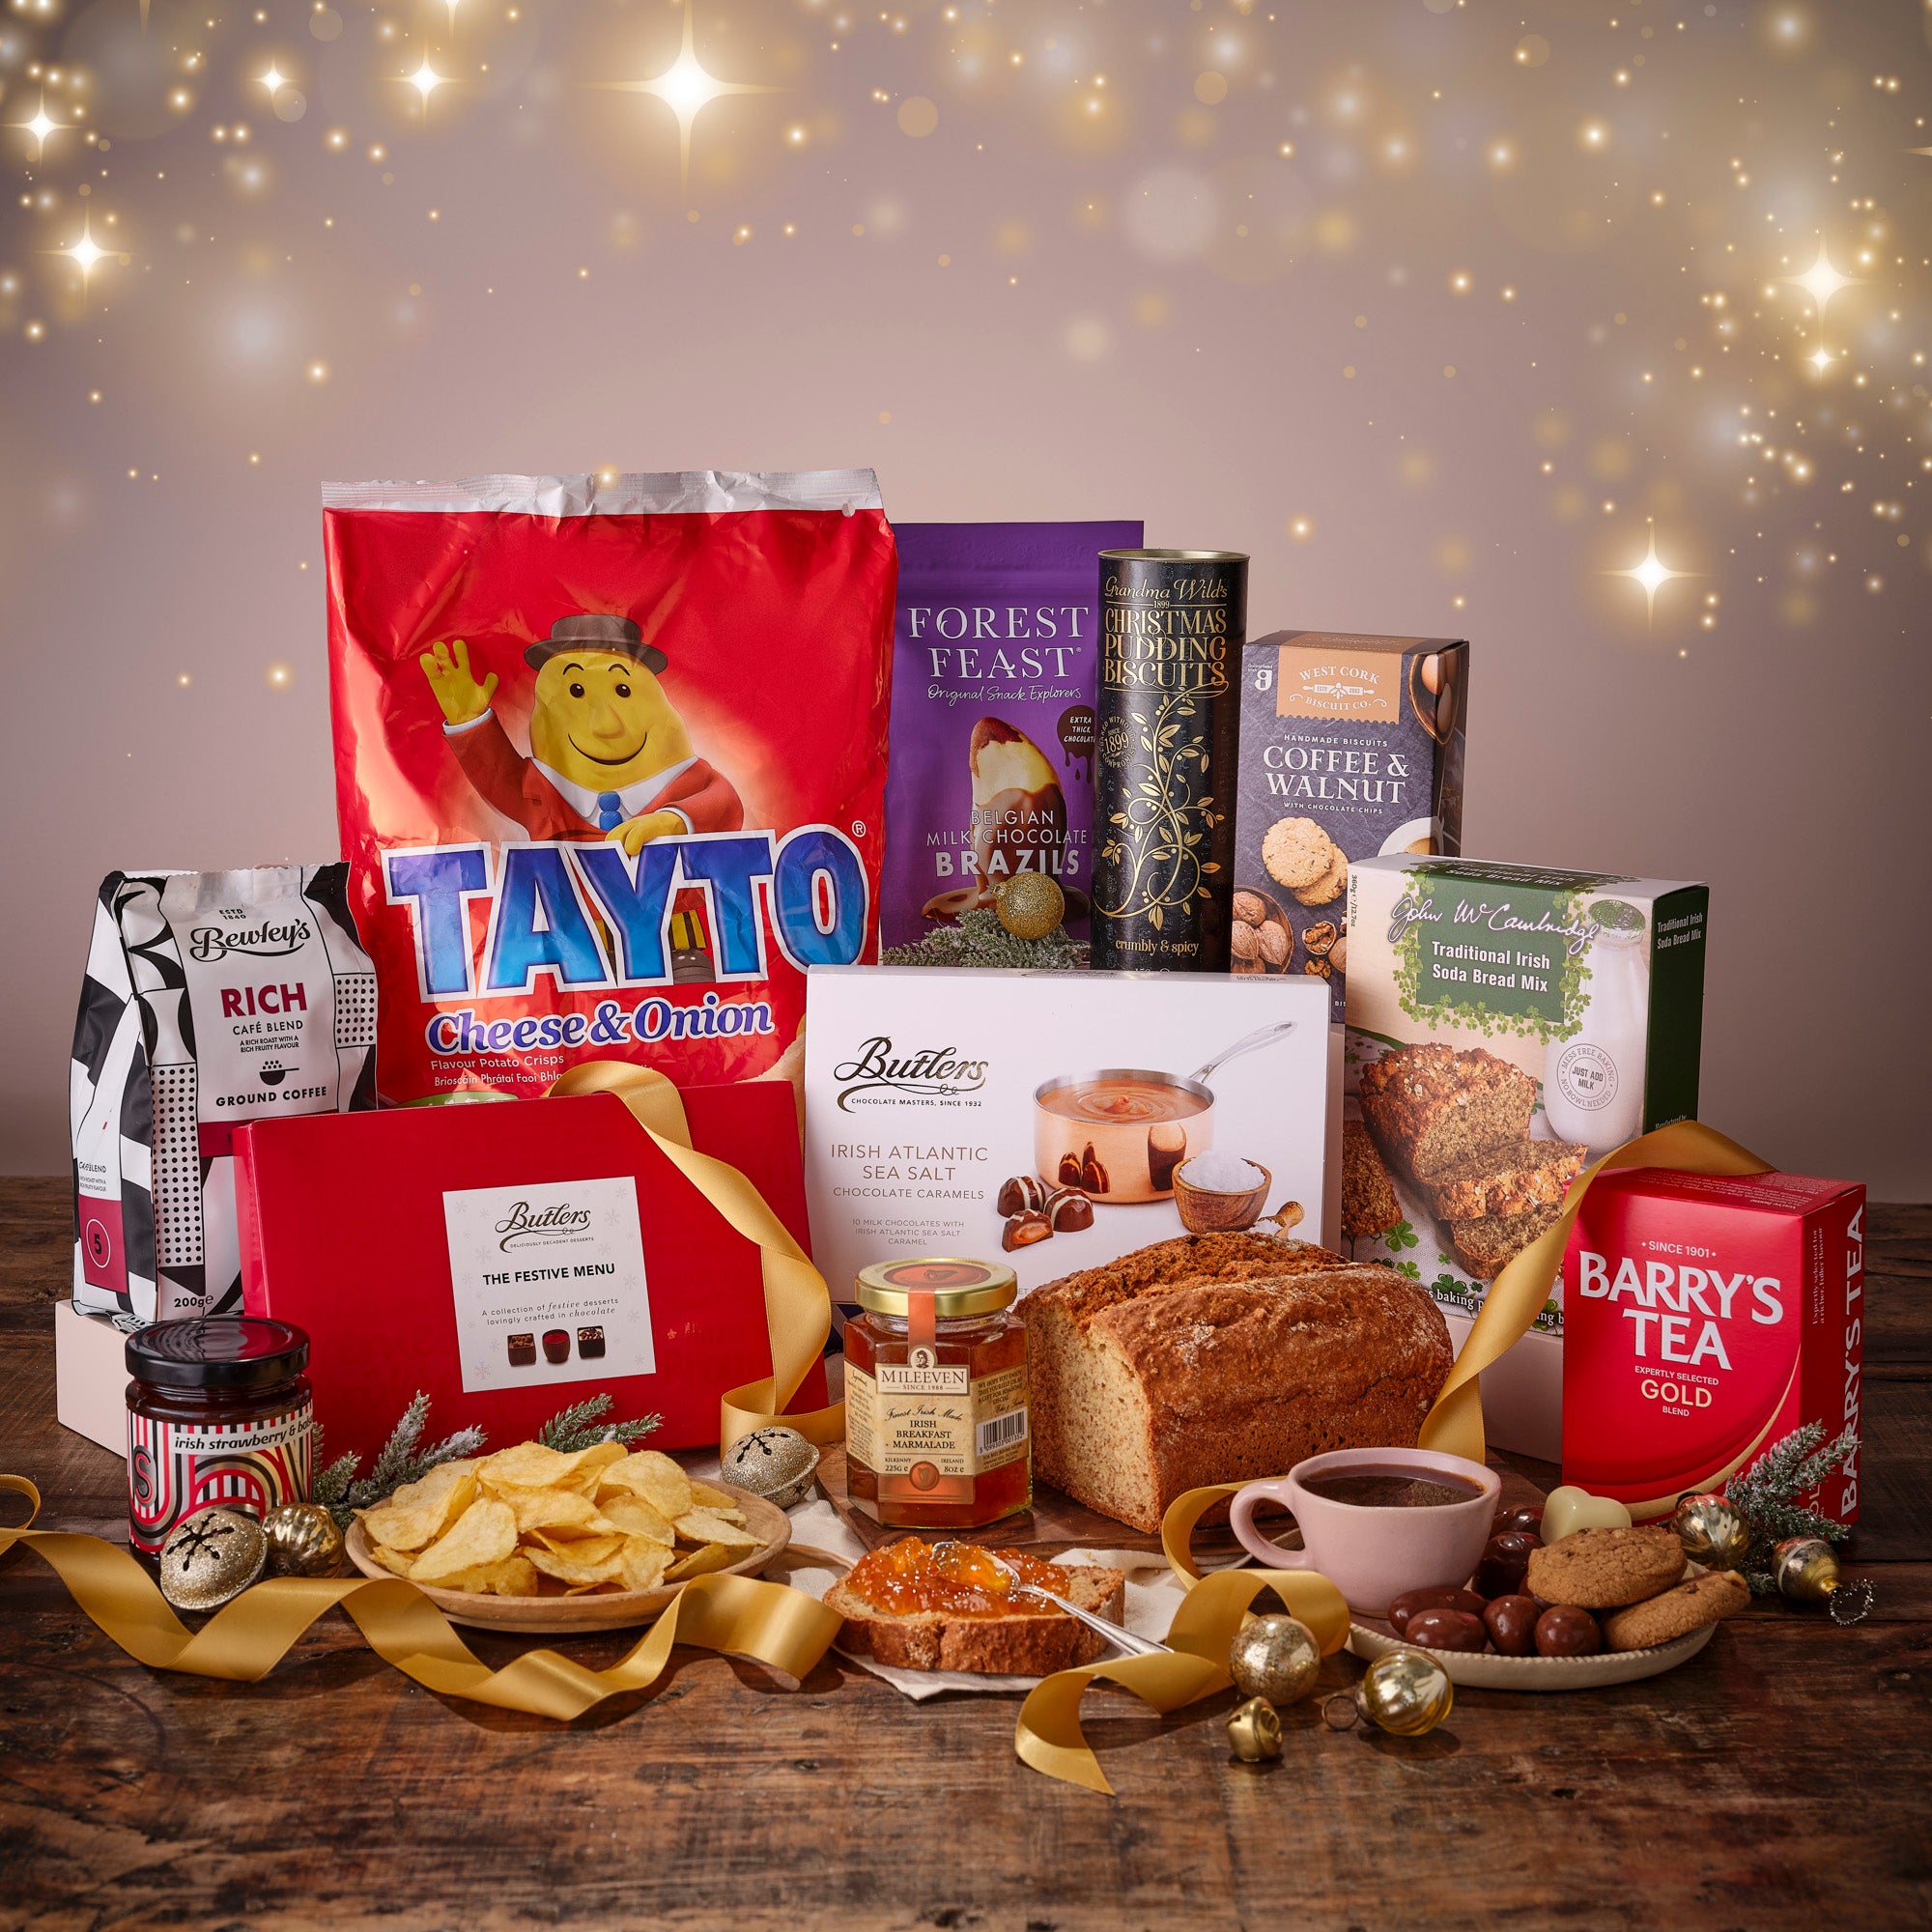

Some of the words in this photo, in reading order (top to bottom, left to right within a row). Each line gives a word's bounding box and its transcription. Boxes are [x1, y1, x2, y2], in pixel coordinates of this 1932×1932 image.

[1104, 577, 1171, 599] Grandma
[1174, 579, 1228, 600] Wild's
[1153, 600, 1170, 609] 1899
[907, 607, 1089, 639] FOREST
[1105, 608, 1227, 635] CHRISTMAS
[1105, 633, 1226, 662] PUDDING
[927, 647, 1074, 679] FEAST
[1104, 659, 1227, 687] BISCUITS
[1298, 666, 1337, 681] WEST
[1340, 667, 1381, 685] CORK
[927, 684, 983, 707] Original
[987, 685, 1027, 701] Snack
[1029, 685, 1082, 703] Explorers
[1305, 697, 1350, 711] BISCUIT
[1104, 732, 1129, 754] 1899
[1284, 734, 1339, 744] HANDMADE
[1343, 738, 1388, 748] BISCUITS
[1263, 746, 1379, 775] COFFEE
[1387, 753, 1410, 778] &
[1264, 772, 1406, 804] WALNUT
[971, 810, 1054, 825] BELGIAN
[1308, 804, 1355, 812] CHOCOLATE
[926, 830, 973, 846] MILK
[982, 829, 1087, 844] CHOCOLATE
[935, 849, 1080, 877] BRAZILS
[1486, 874, 1532, 883] Bread
[382, 823, 868, 1004] TAYTO
[1388, 896, 1443, 943] John
[1658, 915, 1690, 933] Traditional
[1690, 912, 1703, 925] Irish
[189, 919, 311, 962] Bewley's
[1116, 938, 1157, 956] crumbly
[1160, 939, 1170, 952] &
[1172, 941, 1199, 956] spicy
[1658, 936, 1672, 949] Soda
[1673, 931, 1690, 946] Bread
[1690, 928, 1701, 941] Mix
[1432, 941, 1512, 965] Traditional
[1516, 951, 1550, 970] Irish
[1433, 963, 1467, 982] Soda
[1473, 970, 1516, 988] Bread
[1521, 975, 1548, 993] Mix
[220, 982, 307, 1018] RICH
[233, 1021, 263, 1036] CAFÉ
[267, 1020, 303, 1034] BLEND
[431, 1059, 476, 1070] Flavour
[480, 1057, 520, 1068] Potato
[524, 1054, 564, 1067] Crisps
[834, 1036, 989, 1103] Butlers
[1562, 1051, 1577, 1069] MESS
[1577, 1047, 1596, 1057] FREE
[1597, 1053, 1614, 1082] BAKING
[435, 1073, 478, 1087] Brioscáin
[480, 1072, 514, 1084] Phrátaí
[517, 1072, 537, 1083] Faoi
[1572, 1066, 1588, 1078] JUST
[1590, 1070, 1604, 1082] ADD
[1578, 1078, 1595, 1090] MILK
[215, 1091, 277, 1107] GROUND
[283, 1086, 327, 1101] COFFEE
[1561, 1078, 1570, 1091] NO
[1567, 1091, 1586, 1107] BOWL
[1587, 1090, 1611, 1107] NEEDED
[831, 1144, 881, 1159] IRISH
[889, 1146, 988, 1161] ATLANTIC
[863, 1165, 900, 1179] SEA
[908, 1166, 955, 1180] SALT
[833, 1186, 912, 1198] CHOCOLATE
[917, 1189, 984, 1200] CARAMELS
[495, 1201, 591, 1240] Butlers
[94, 1234, 102, 1255] 5
[1648, 1240, 1683, 1255] SINCE
[1685, 1245, 1710, 1258] 1901
[1846, 1204, 1863, 1316] TEA
[483, 1272, 510, 1286] THE
[515, 1267, 569, 1283] FESTIVE
[574, 1263, 615, 1278] MENU
[1578, 1250, 1784, 1326] BARRY'S
[491, 1306, 533, 1316] collection
[547, 1301, 580, 1312] festive
[582, 1298, 618, 1307] desserts
[1436, 1289, 1474, 1311] baking
[487, 1315, 521, 1325] lovingly
[525, 1313, 554, 1322] crafted
[569, 1307, 615, 1318] chocolate
[1622, 1308, 1733, 1371] TEA
[881, 1370, 964, 1384] MILEEVEN
[1634, 1365, 1675, 1379] EXPERTLY
[1676, 1372, 1719, 1386] SELECTED
[1640, 1378, 1713, 1408] GOLD
[885, 1407, 912, 1421] Finest
[913, 1405, 937, 1416] Irish
[938, 1408, 963, 1422] Made
[1662, 1406, 1690, 1417] BLEND
[175, 1437, 205, 1449] irish
[209, 1430, 287, 1450] strawberry
[289, 1426, 297, 1436] &
